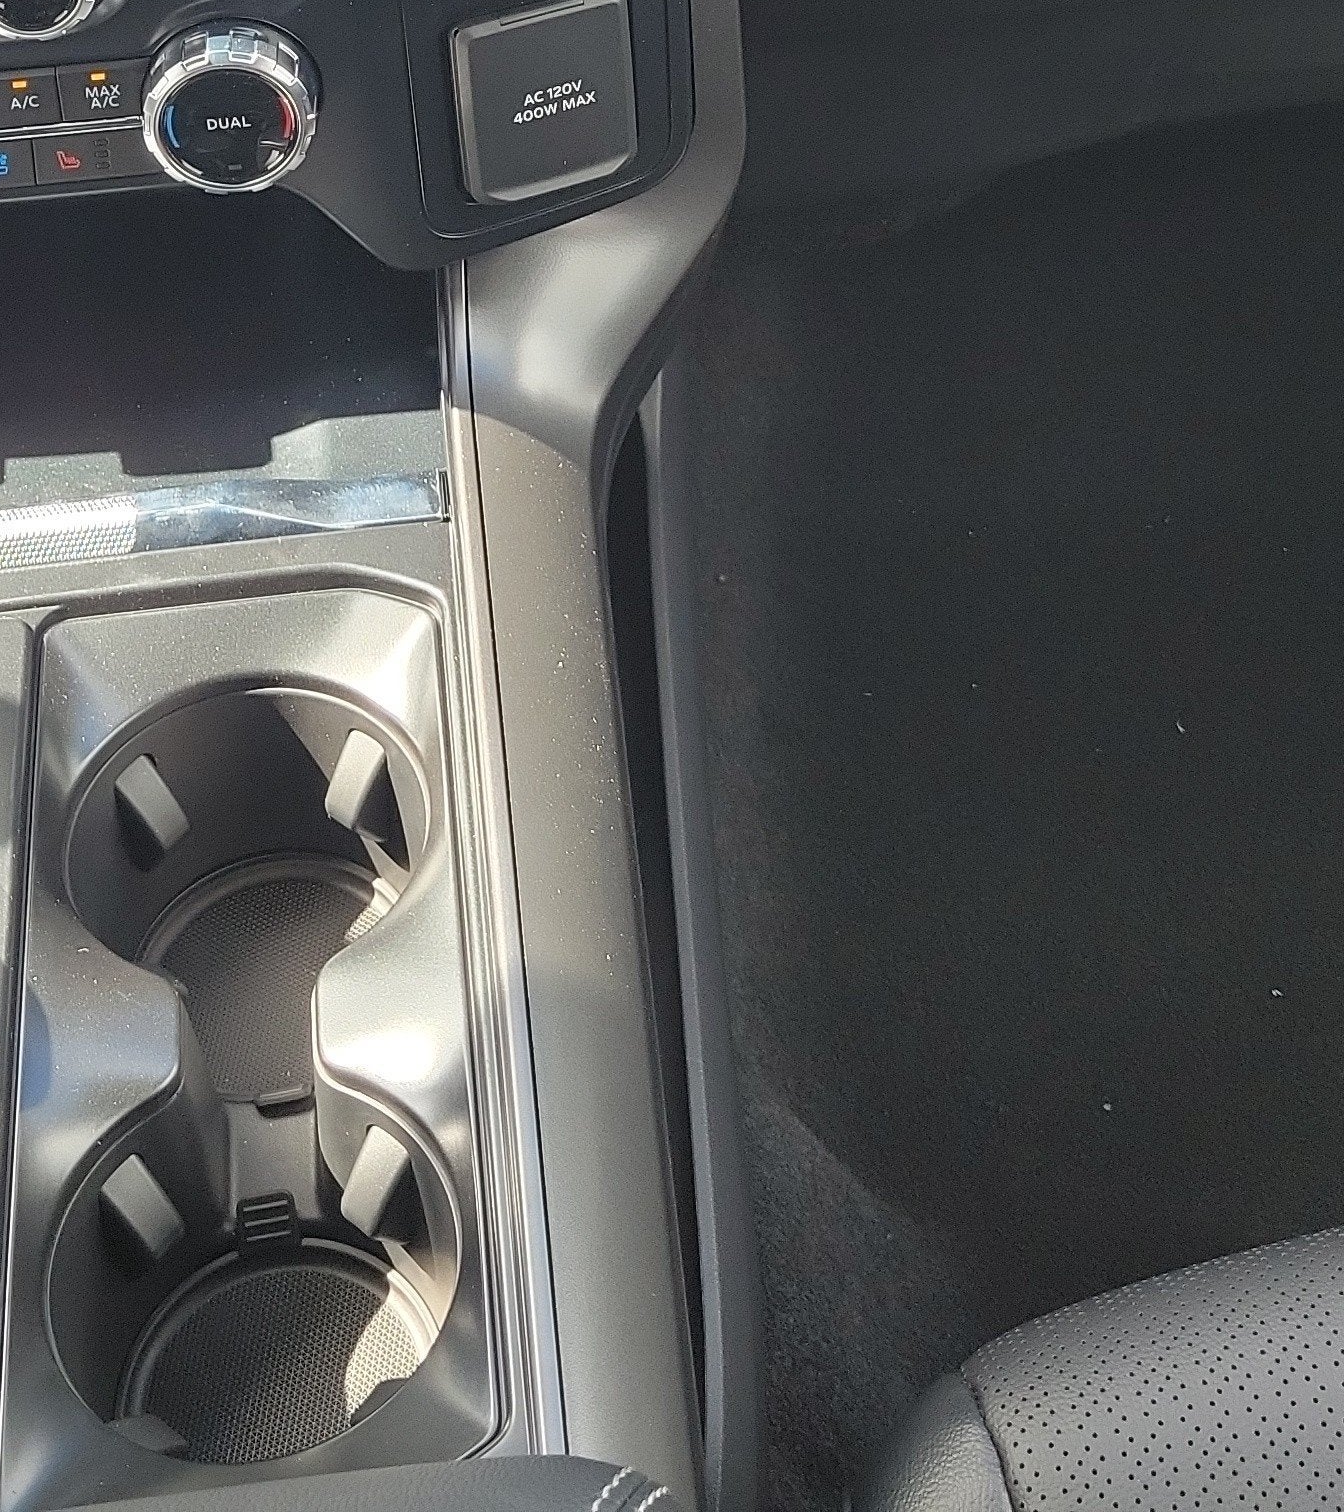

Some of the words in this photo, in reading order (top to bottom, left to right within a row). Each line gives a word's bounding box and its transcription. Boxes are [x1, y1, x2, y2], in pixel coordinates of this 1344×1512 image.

[84, 83, 121, 99] MAX
[524, 90, 545, 108] AC
[547, 78, 584, 100] 120V
[10, 95, 40, 110] A/C
[90, 95, 120, 110] A/C
[513, 102, 558, 126] 400W
[562, 90, 596, 113] MAX
[205, 114, 252, 132] DUAL
